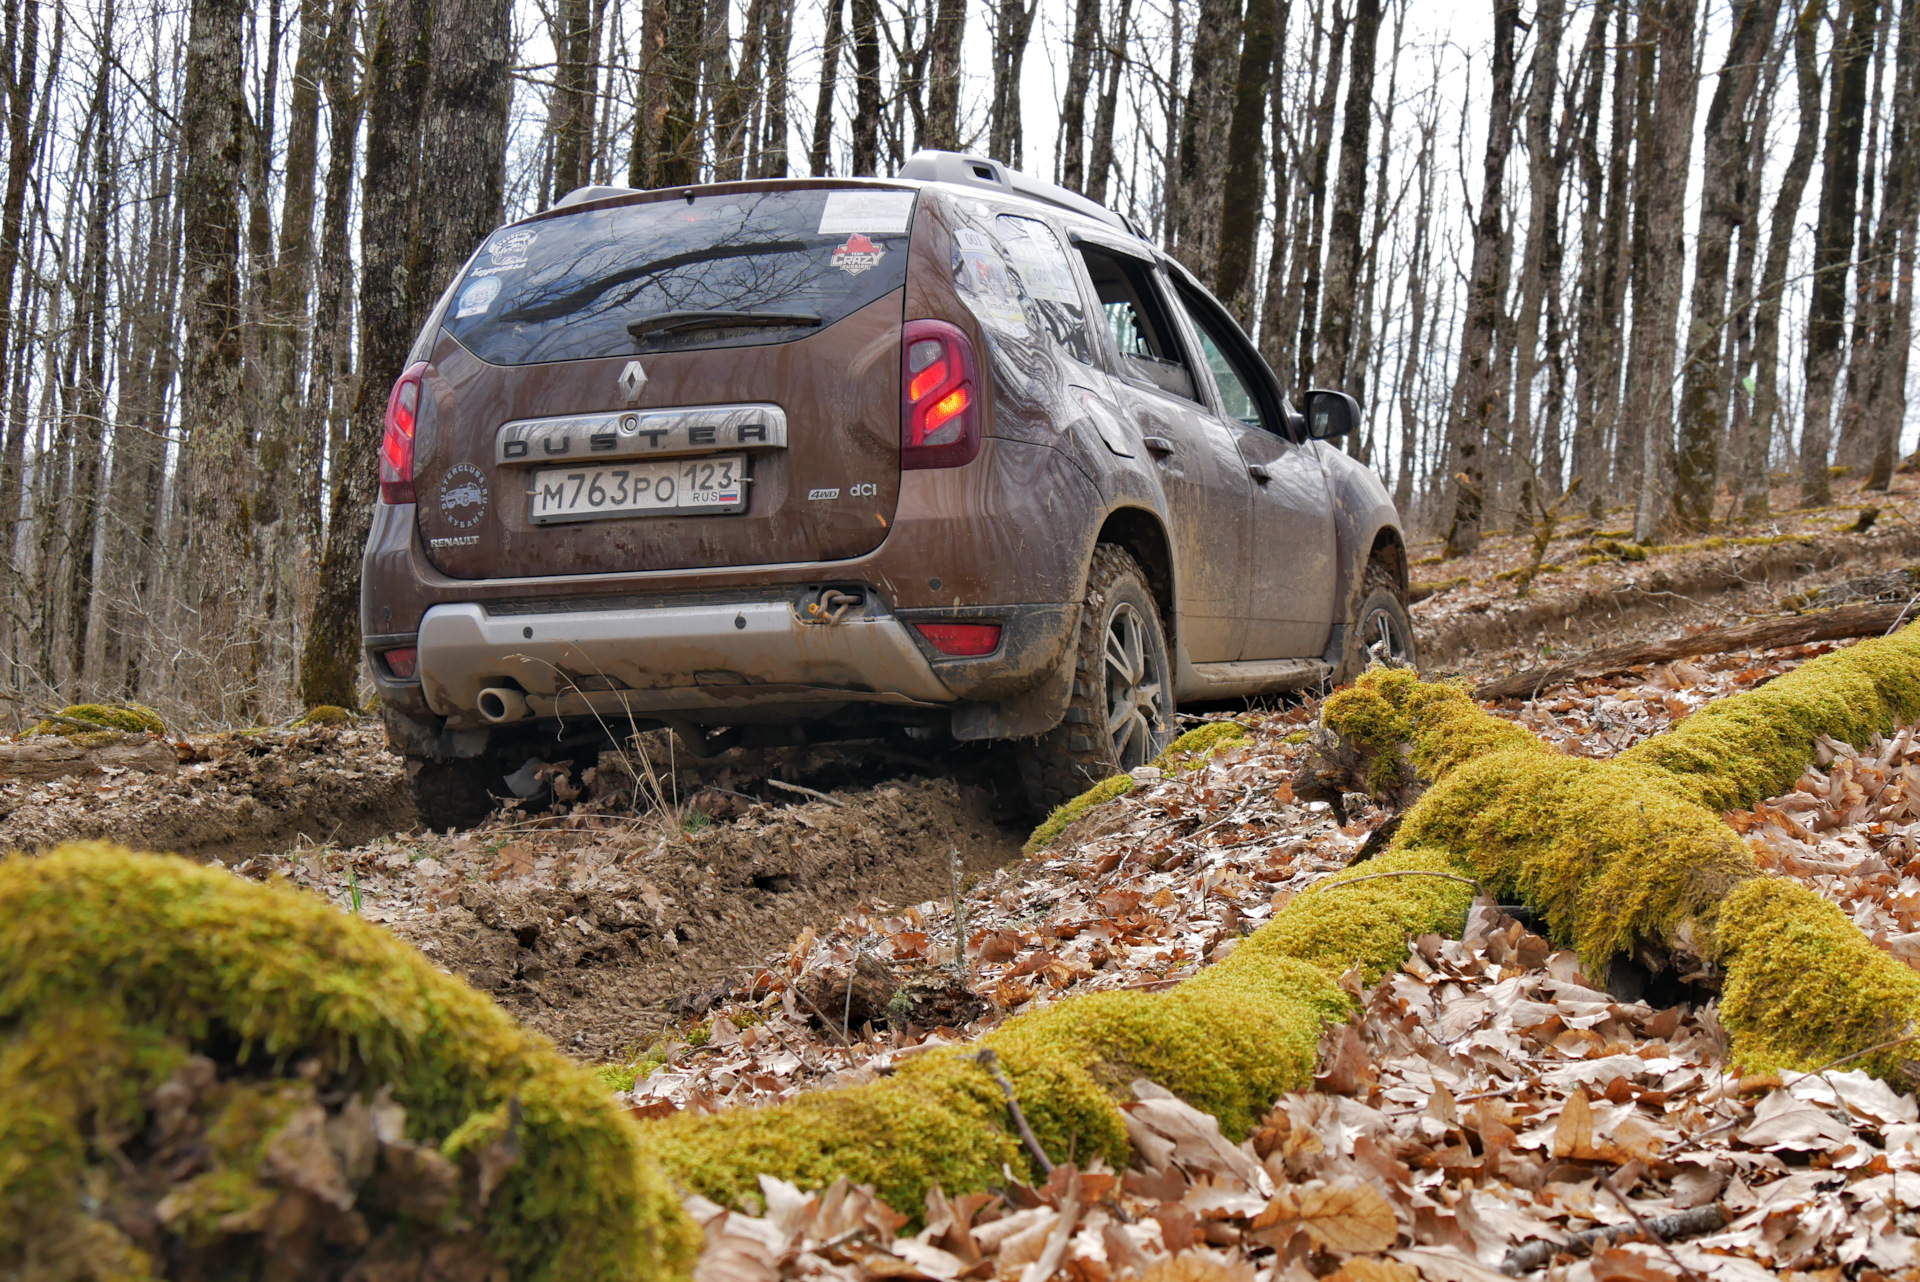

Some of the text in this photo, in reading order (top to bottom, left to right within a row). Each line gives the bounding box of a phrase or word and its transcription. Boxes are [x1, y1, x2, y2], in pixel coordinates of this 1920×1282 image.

[964, 232, 984, 247] 001
[833, 251, 886, 265] CRAZY
[503, 424, 766, 458] DUSTER
[683, 461, 734, 491] 123
[440, 464, 488, 510] DUSTERCLUBS.RU
[810, 489, 838, 499] 4WD
[692, 491, 718, 503] RUS
[447, 510, 485, 529] КУБАНЬ
[430, 535, 480, 548] RENAULT
